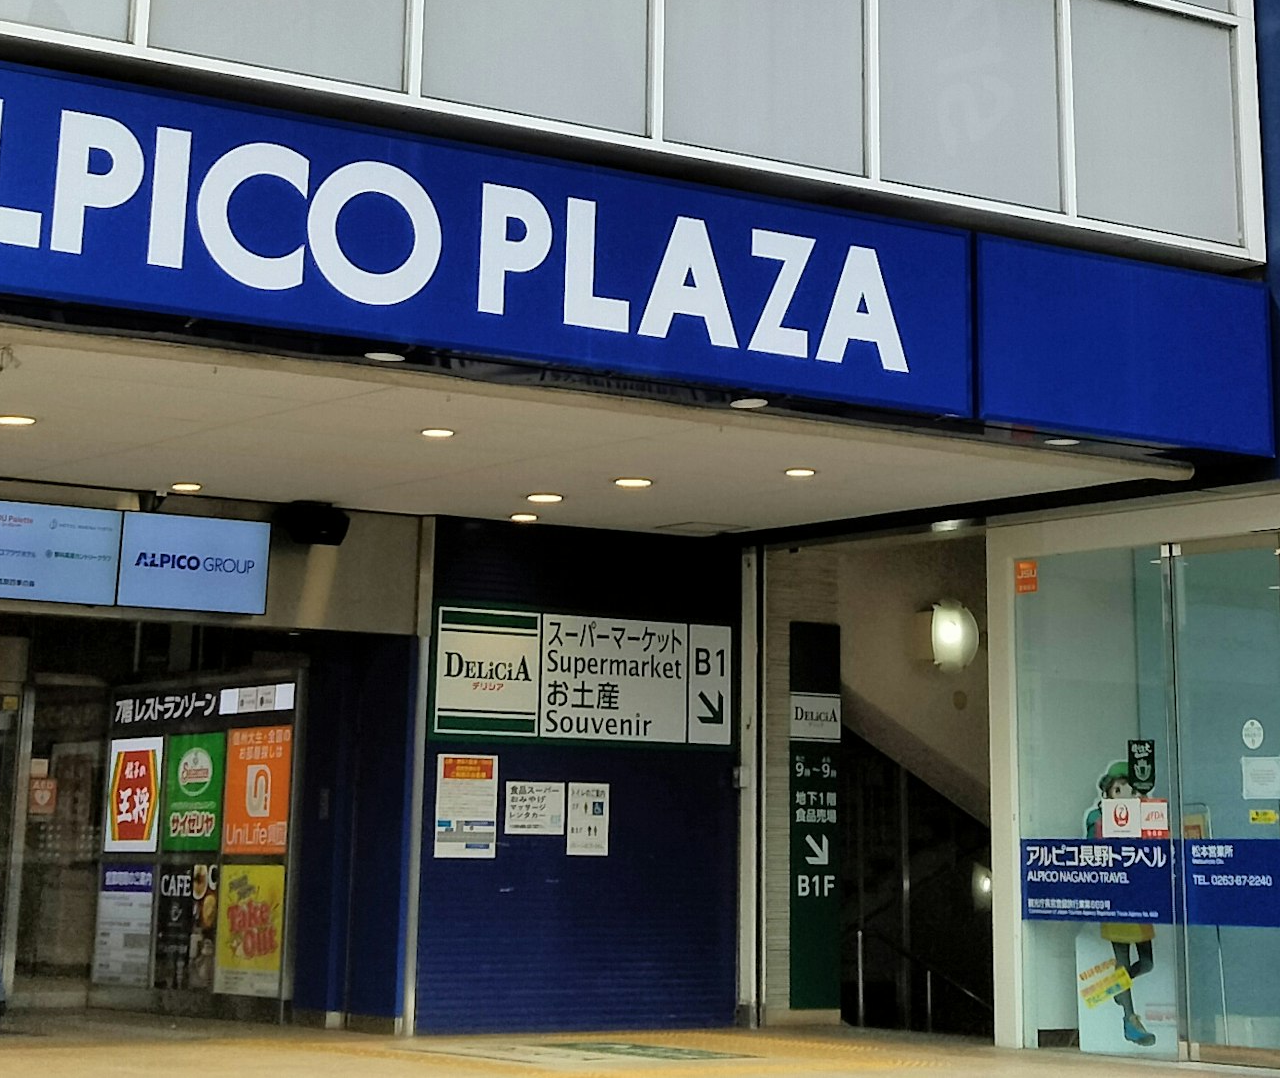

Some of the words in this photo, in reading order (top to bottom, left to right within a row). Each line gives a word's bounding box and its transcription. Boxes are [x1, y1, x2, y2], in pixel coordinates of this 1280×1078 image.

[477, 183, 910, 374] PLAZA
[135, 551, 200, 570] ALPICO
[203, 557, 255, 575] GROUP
[548, 622, 683, 654] スーパーマーケット
[547, 650, 683, 680] Supermarket
[695, 648, 725, 677] B1
[472, 682, 504, 691] デリシア
[547, 680, 620, 711] お土産
[115, 692, 216, 723] 7階レストランゾーン
[546, 710, 653, 737] Souvenir
[32, 780, 54, 789] AED
[510, 785, 559, 795] 食品スーパー
[117, 788, 149, 825] 王将
[795, 791, 837, 807] 地下1階
[170, 811, 215, 837] サイゼリヤ
[510, 811, 546, 819] レンタカー
[795, 808, 837, 823] 食品売場
[226, 823, 267, 846] UniLife
[1026, 844, 1167, 868] アルピコ長野トラベル
[1191, 844, 1234, 858] 松本営業所
[797, 875, 835, 897] B1F
[1027, 870, 1059, 883] ALPICO
[1060, 871, 1099, 884] NAGANO
[1100, 872, 1130, 884] TRAVEL
